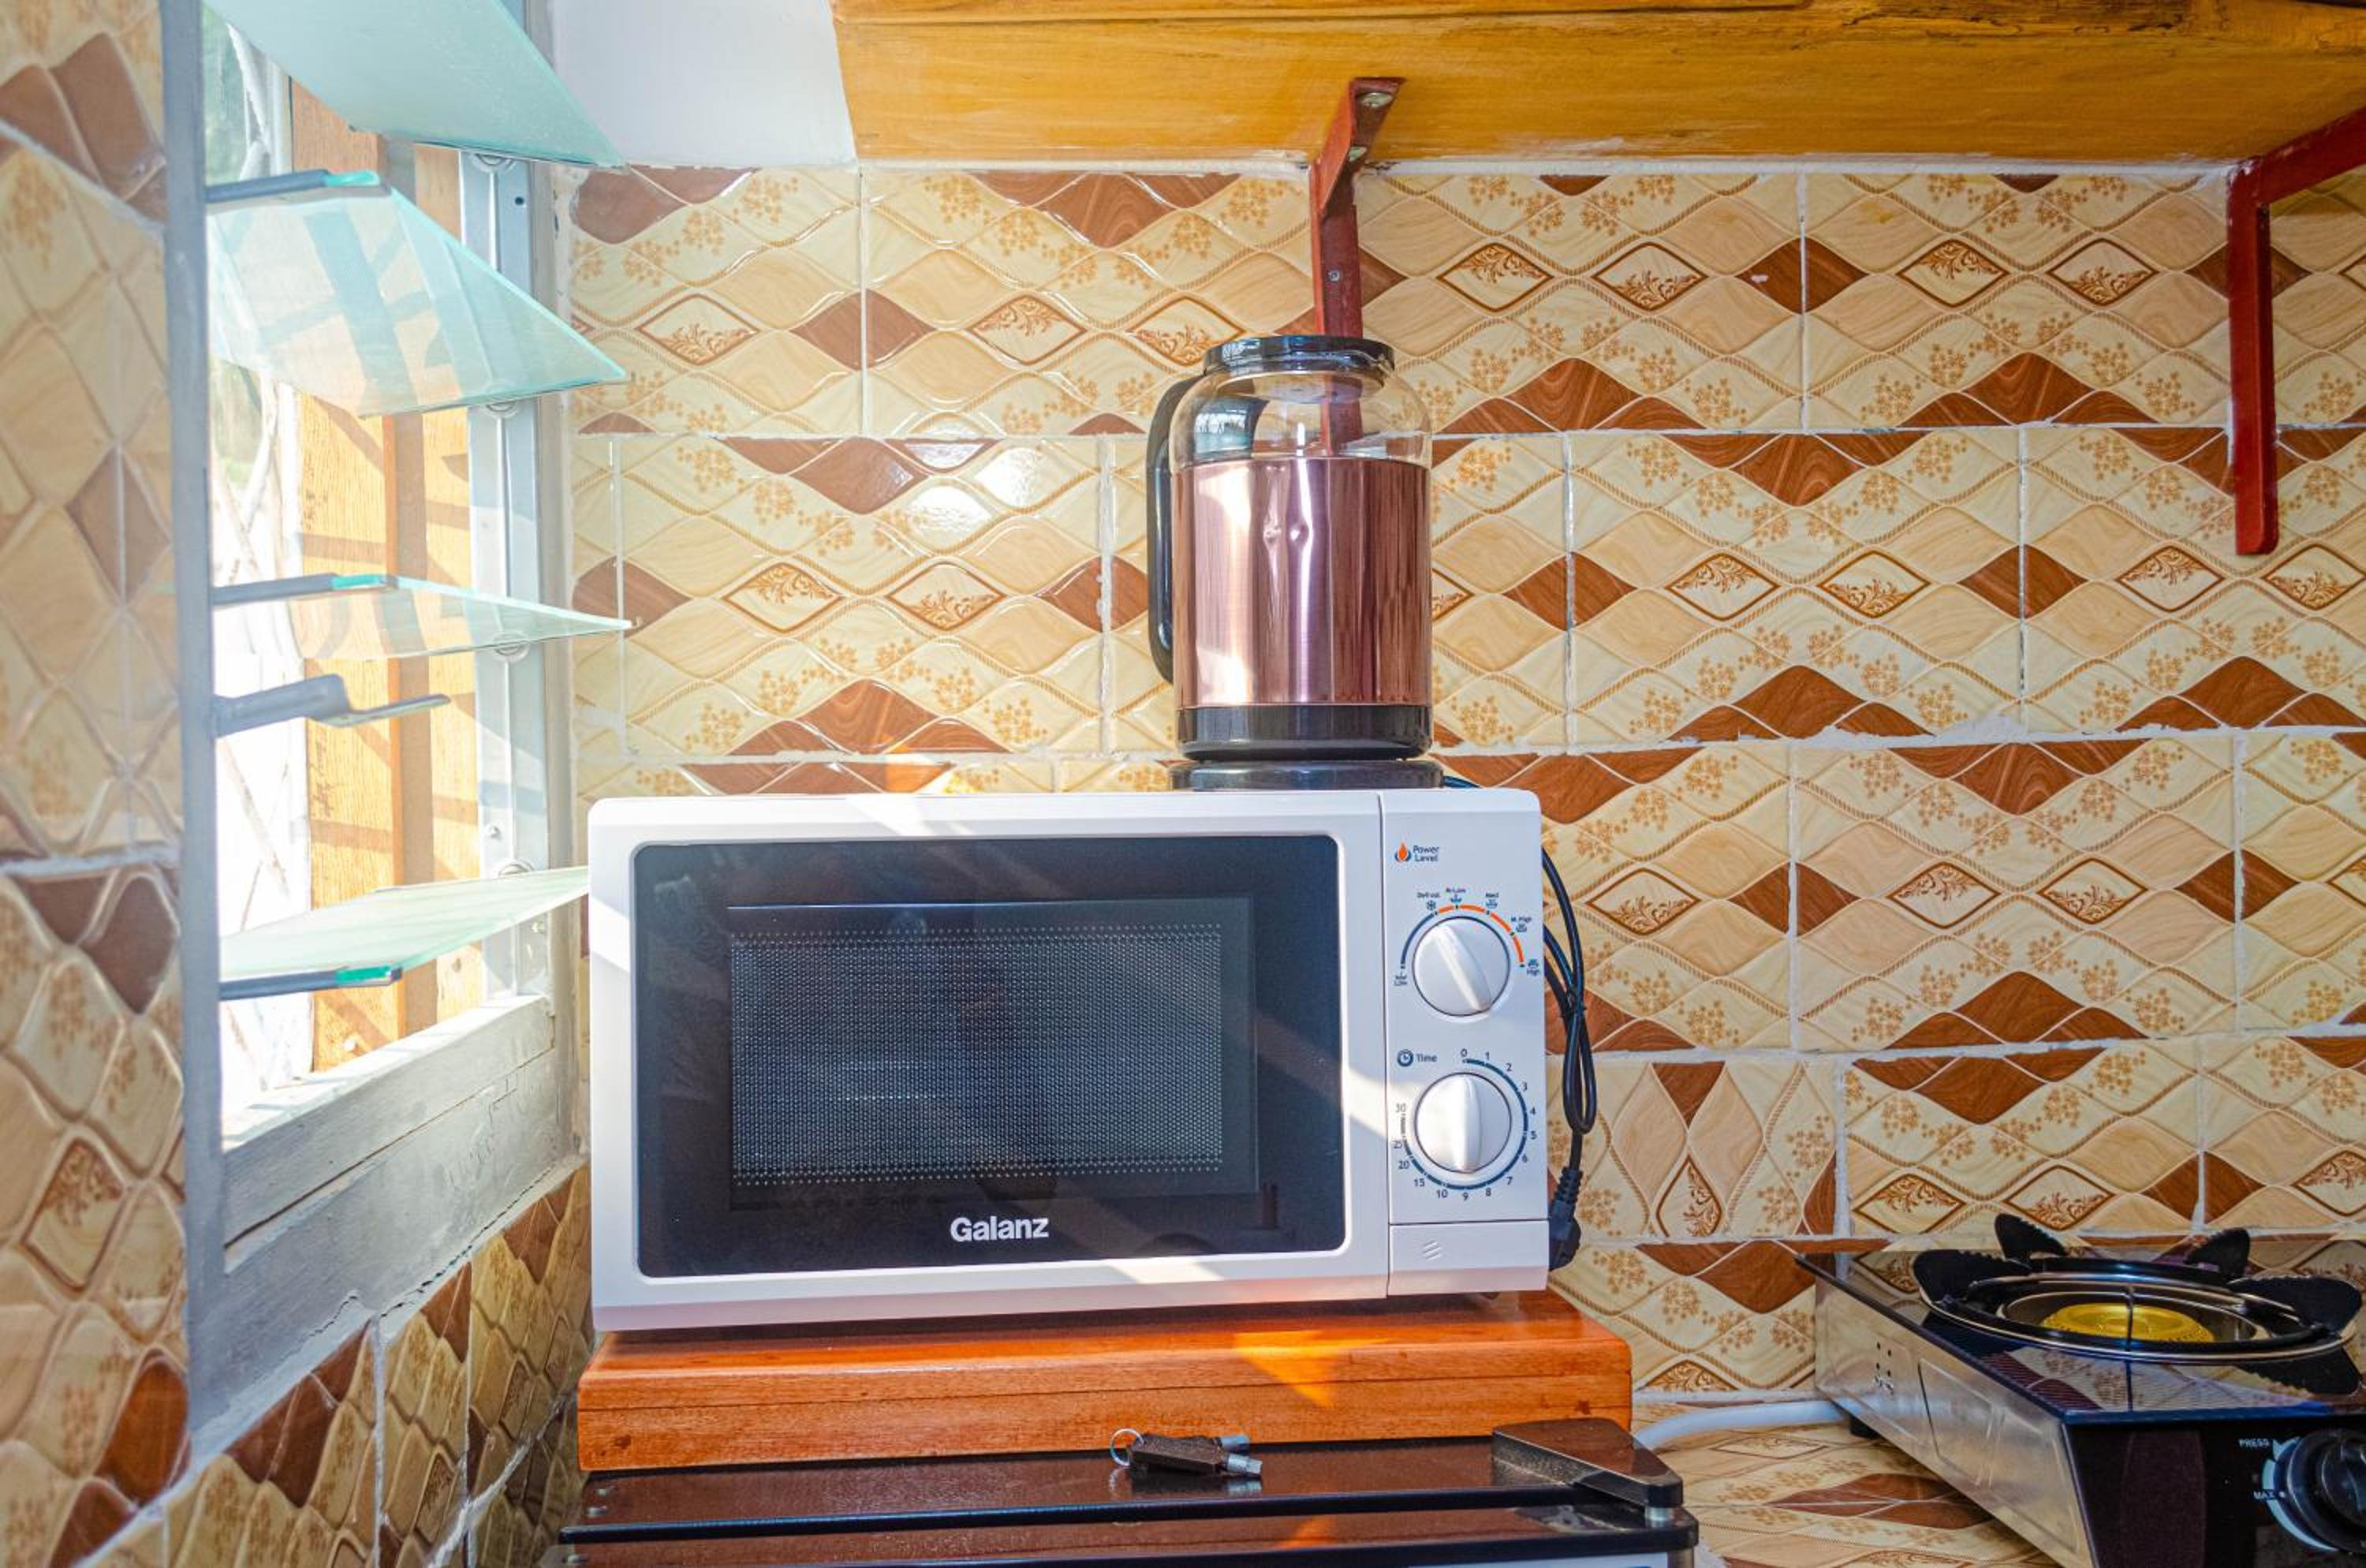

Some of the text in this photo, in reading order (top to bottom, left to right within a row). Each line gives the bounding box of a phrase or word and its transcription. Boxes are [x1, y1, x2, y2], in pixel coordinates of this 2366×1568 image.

[1413, 845, 1439, 853] Power
[1416, 1054, 1438, 1062] Time
[1461, 1049, 1468, 1058] 0
[1506, 1063, 1513, 1072] 2
[1522, 1083, 1528, 1092] 3
[1395, 1103, 1406, 1113] 30
[1529, 1107, 1536, 1115] 4
[1530, 1131, 1537, 1140] 5
[1394, 1141, 1403, 1149] 25
[1398, 1160, 1410, 1169] 20
[1435, 1189, 1449, 1198] 10
[1462, 1192, 1469, 1200] 9
[1484, 1188, 1491, 1197] 8
[950, 1215, 1050, 1242] Galanz
[2238, 1438, 2270, 1448] PRESS
[2253, 1491, 2275, 1499] MAX
